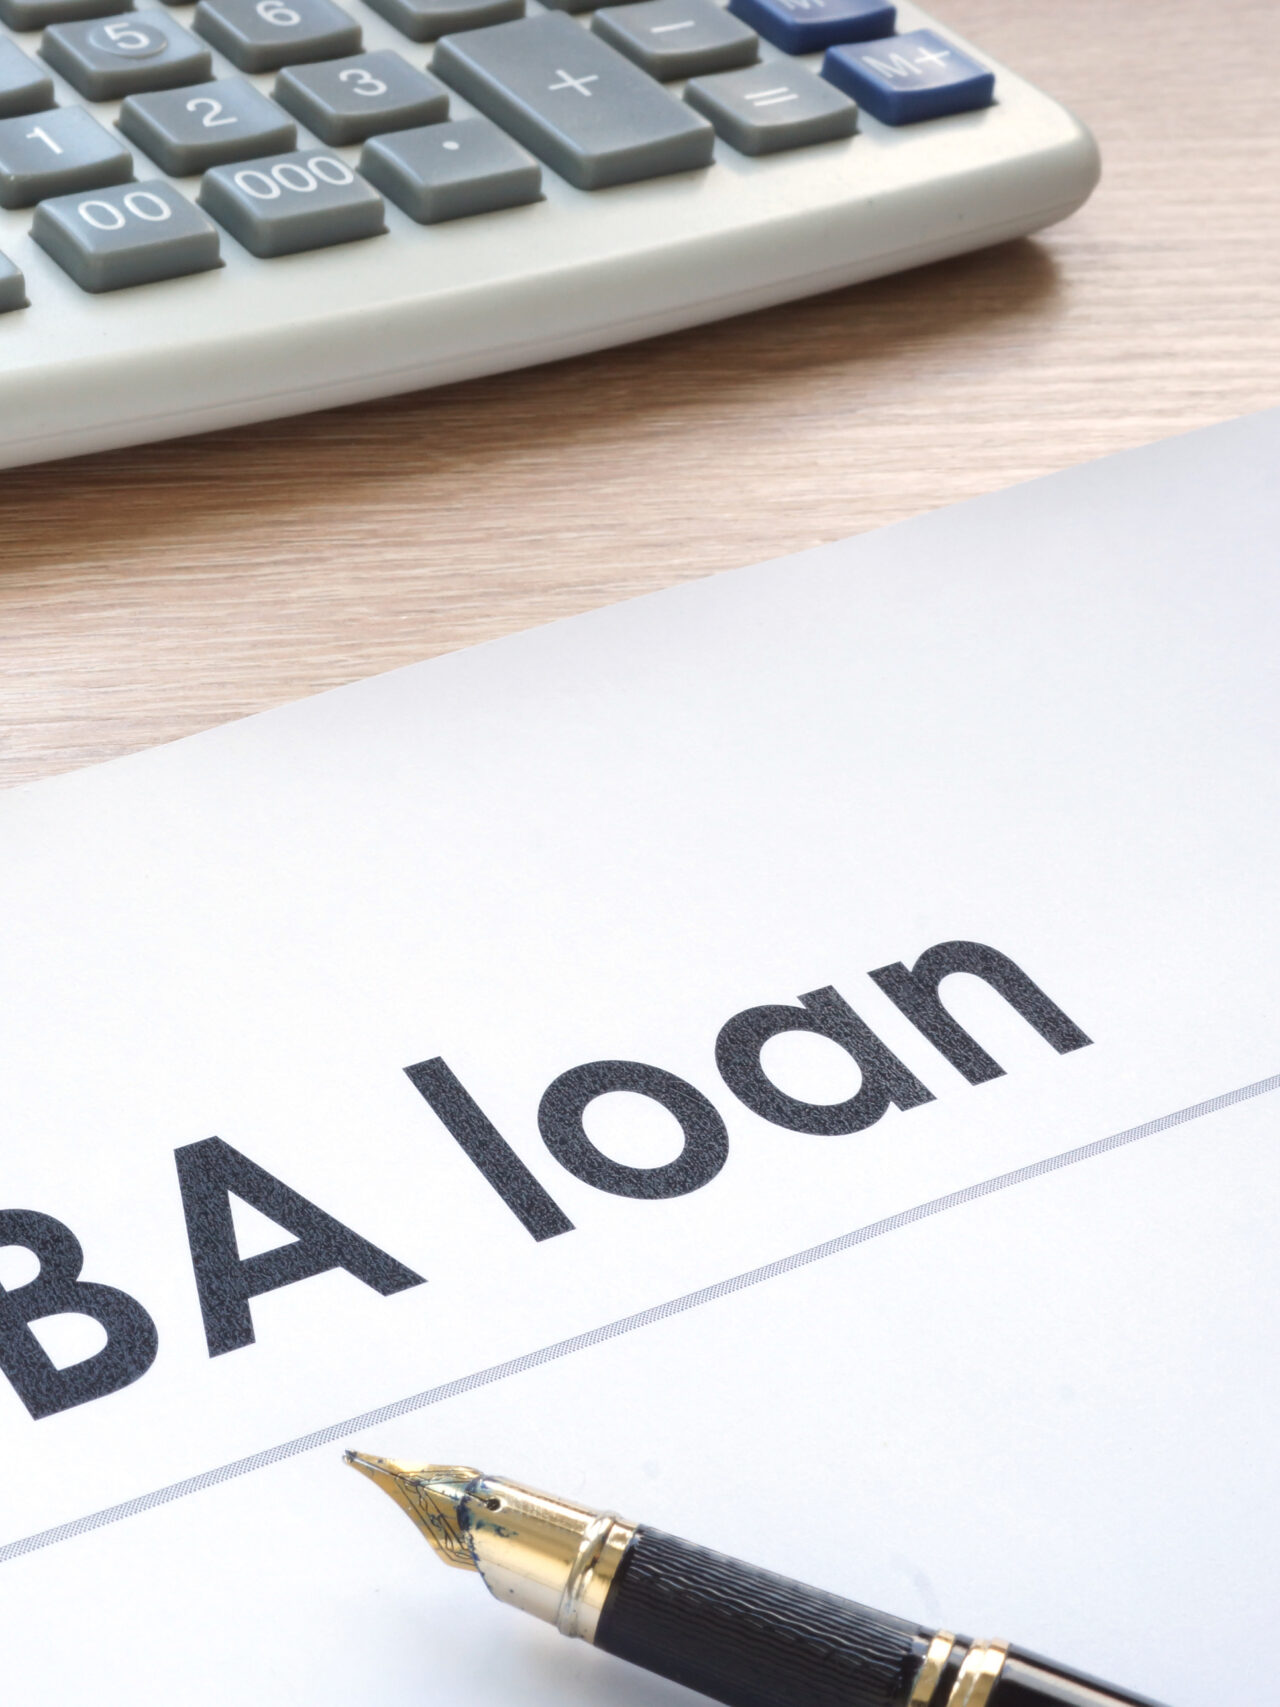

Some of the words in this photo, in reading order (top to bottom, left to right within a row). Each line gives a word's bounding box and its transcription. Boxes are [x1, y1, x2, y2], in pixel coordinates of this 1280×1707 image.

[256, 0, 301, 26] 6
[104, 22, 151, 49] 5
[861, 46, 951, 79] M+
[339, 68, 388, 96] 3
[186, 97, 238, 128] 2
[26, 126, 63, 155] 1
[233, 156, 354, 200] 000
[77, 191, 172, 230] 00
[403, 940, 1094, 1242] loan
